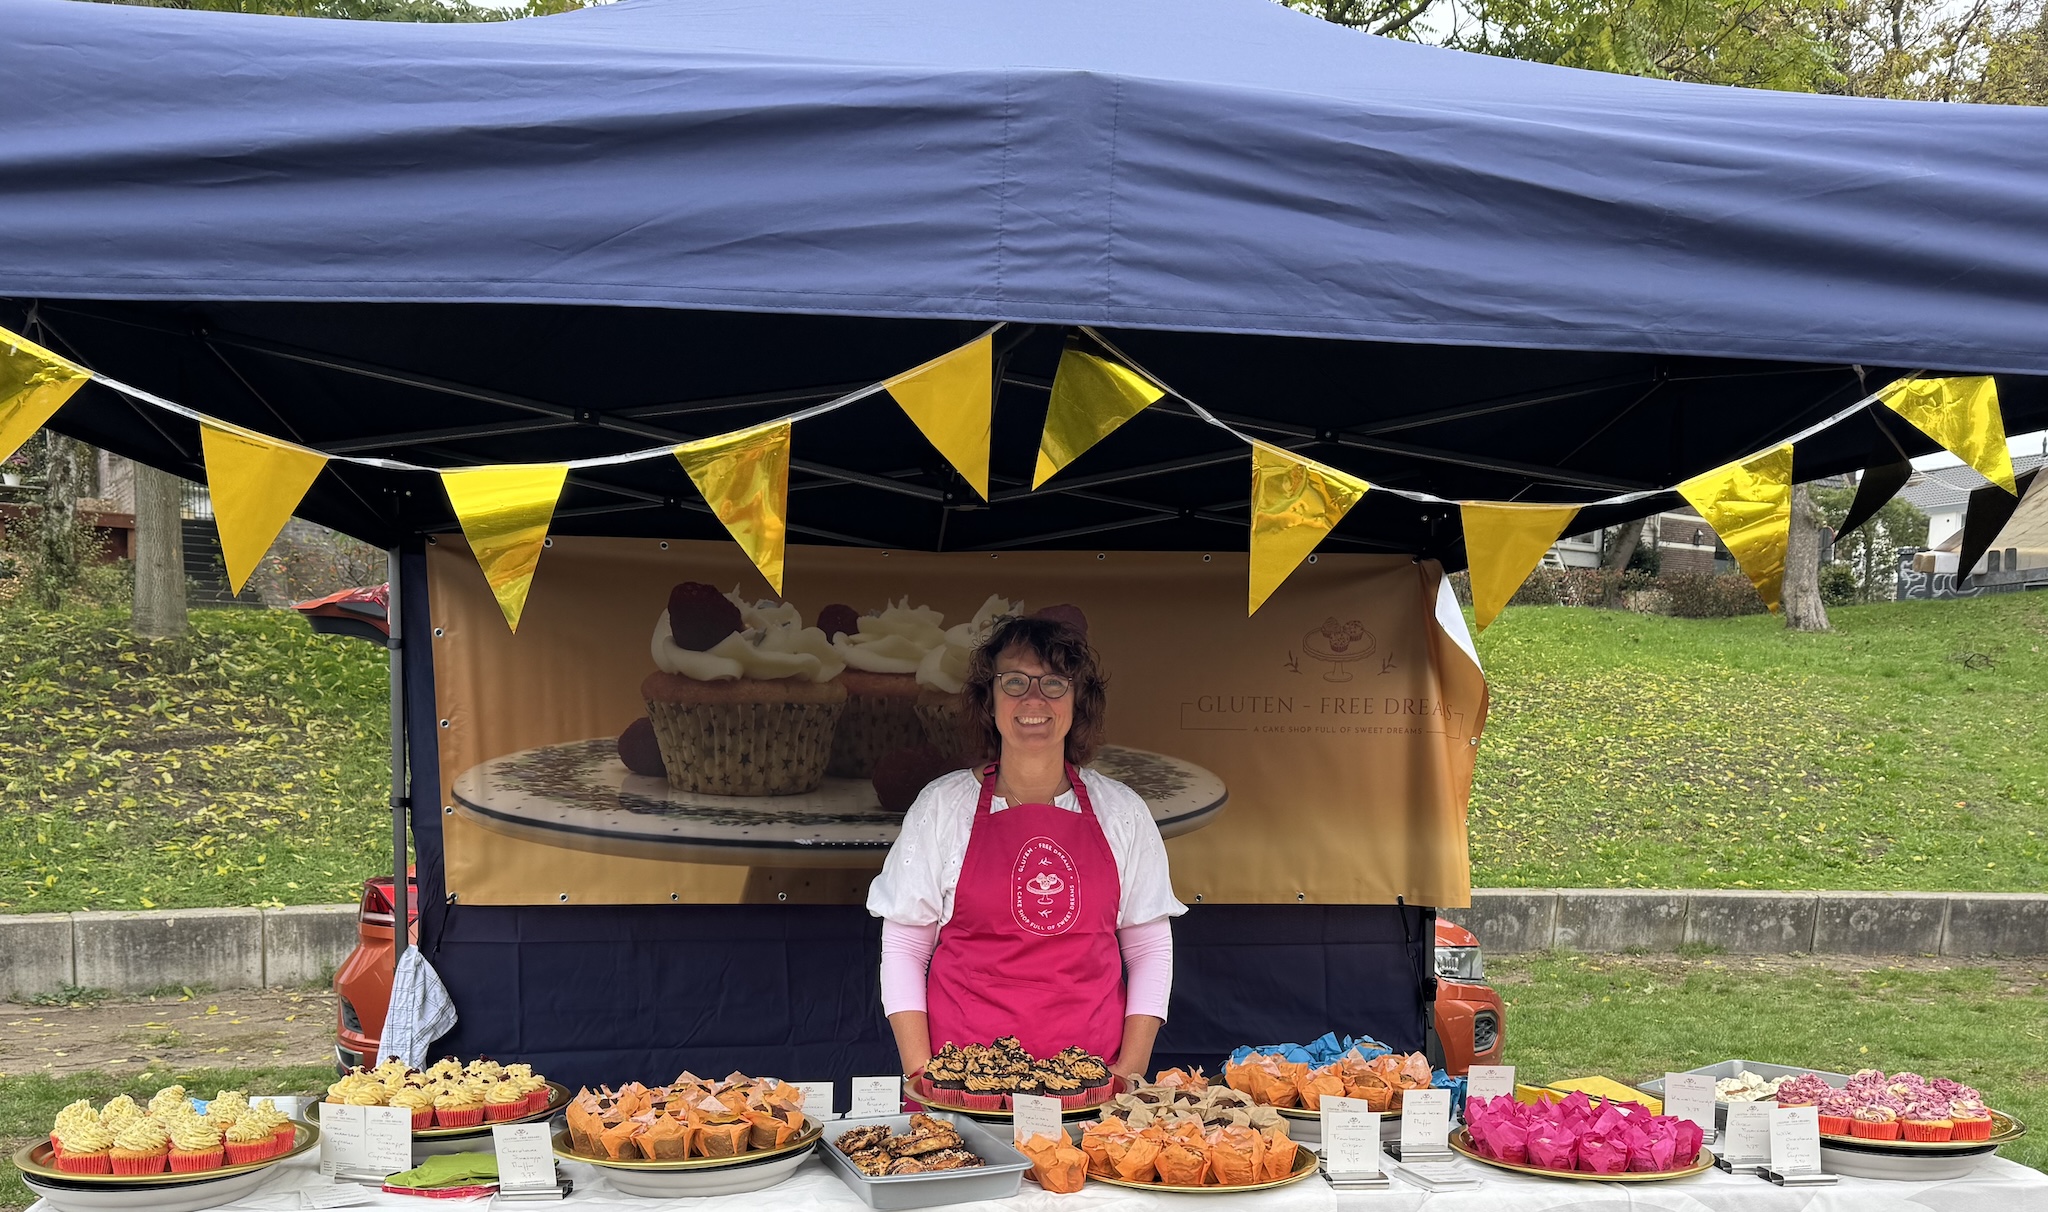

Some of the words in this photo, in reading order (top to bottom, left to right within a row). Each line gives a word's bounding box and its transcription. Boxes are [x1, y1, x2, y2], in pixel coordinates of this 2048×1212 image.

[1197, 695, 1294, 714] GLUTEN
[1320, 697, 1374, 715] FREE
[1383, 698, 1453, 721] DREAS
[1262, 726, 1286, 734] CAKE
[1288, 726, 1312, 734] SHOP
[1315, 726, 1337, 734] FULL
[1354, 726, 1383, 735] SWEET
[1386, 726, 1423, 735] DREAMS
[1018, 847, 1033, 872] GLUTEN
[1038, 843, 1053, 851] FREE
[1018, 909, 1030, 924] SHOP
[1030, 922, 1045, 931] FULL
[1057, 911, 1073, 928] SWEET
